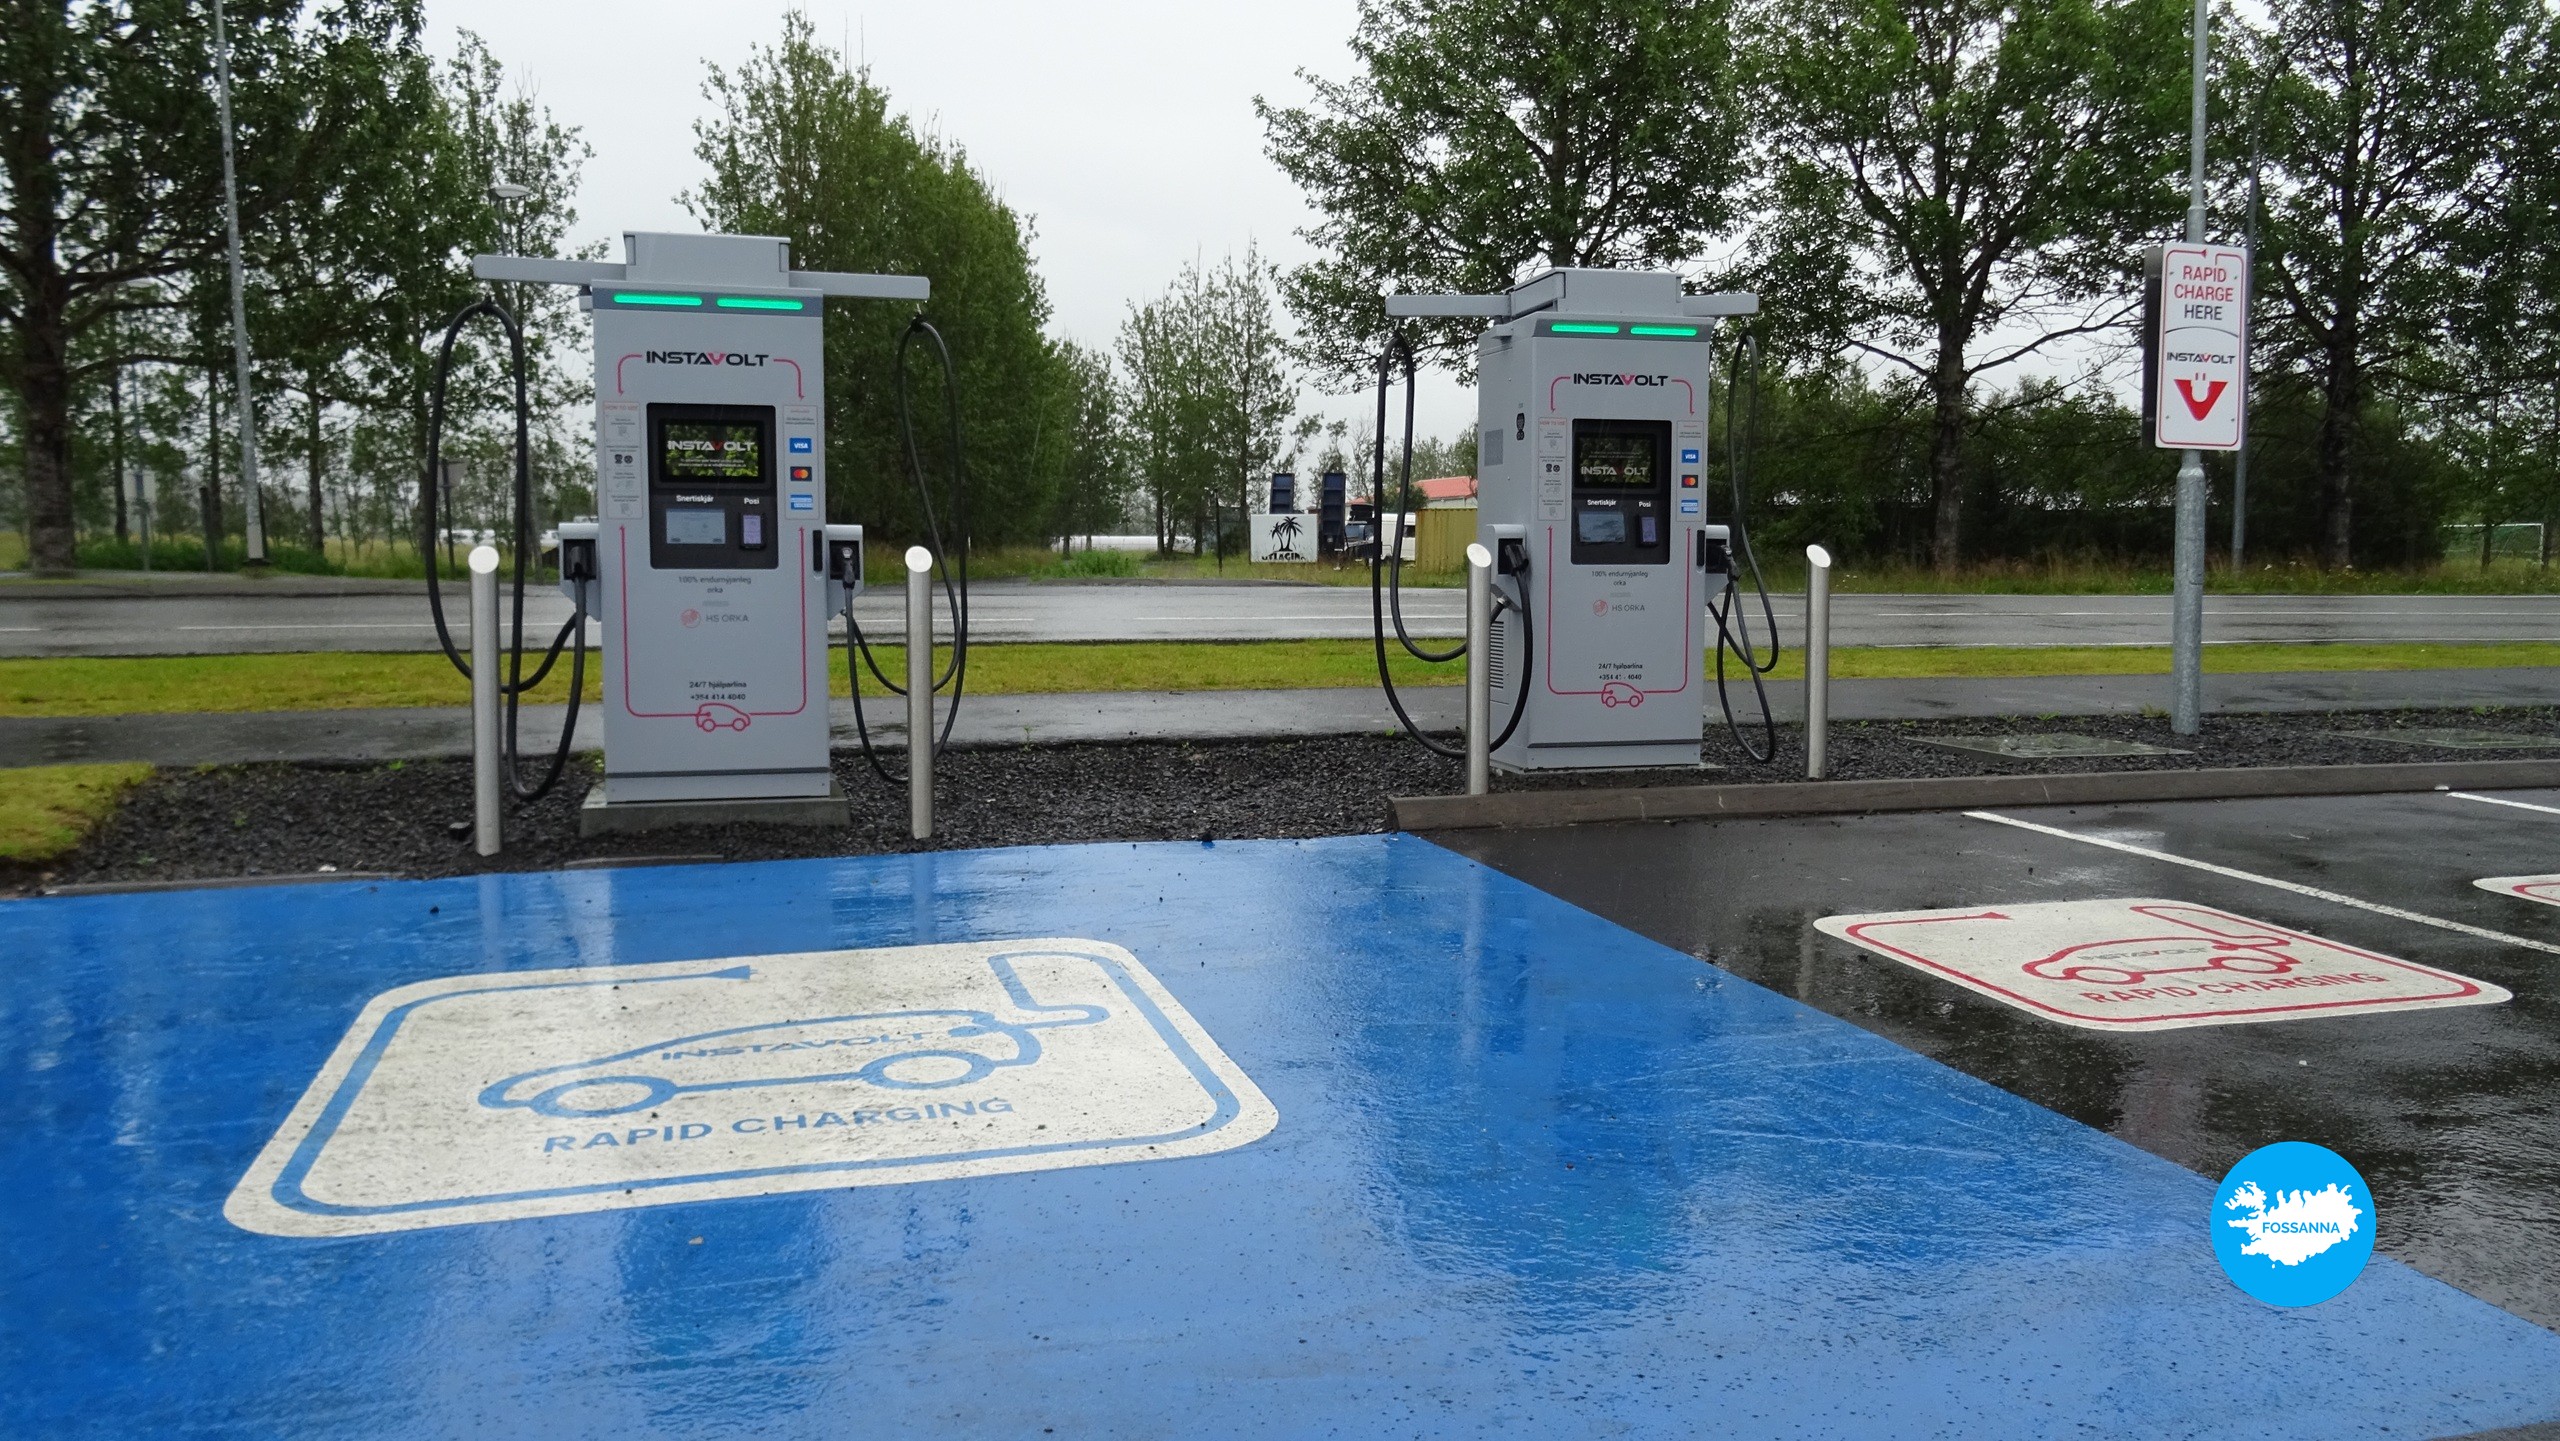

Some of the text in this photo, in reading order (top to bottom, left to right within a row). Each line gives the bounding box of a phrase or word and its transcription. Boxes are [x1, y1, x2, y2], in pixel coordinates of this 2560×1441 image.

[2183, 266, 2226, 282] RAPID
[2174, 284, 2234, 302] CHARGE
[2184, 304, 2223, 321] HERE
[646, 350, 769, 367] INSTAVOLT
[2166, 352, 2236, 365] INSTAVOLT
[1573, 373, 1669, 387] INSTAVOLT
[667, 440, 756, 452] INSTAVOLT
[743, 497, 760, 505] Posi
[705, 614, 750, 622] HS ORKA
[2080, 972, 2388, 1002] RAPID CHARGING
[662, 1030, 933, 1061] INSTAVOLT
[543, 1098, 1015, 1154] RAPID CHARGING
